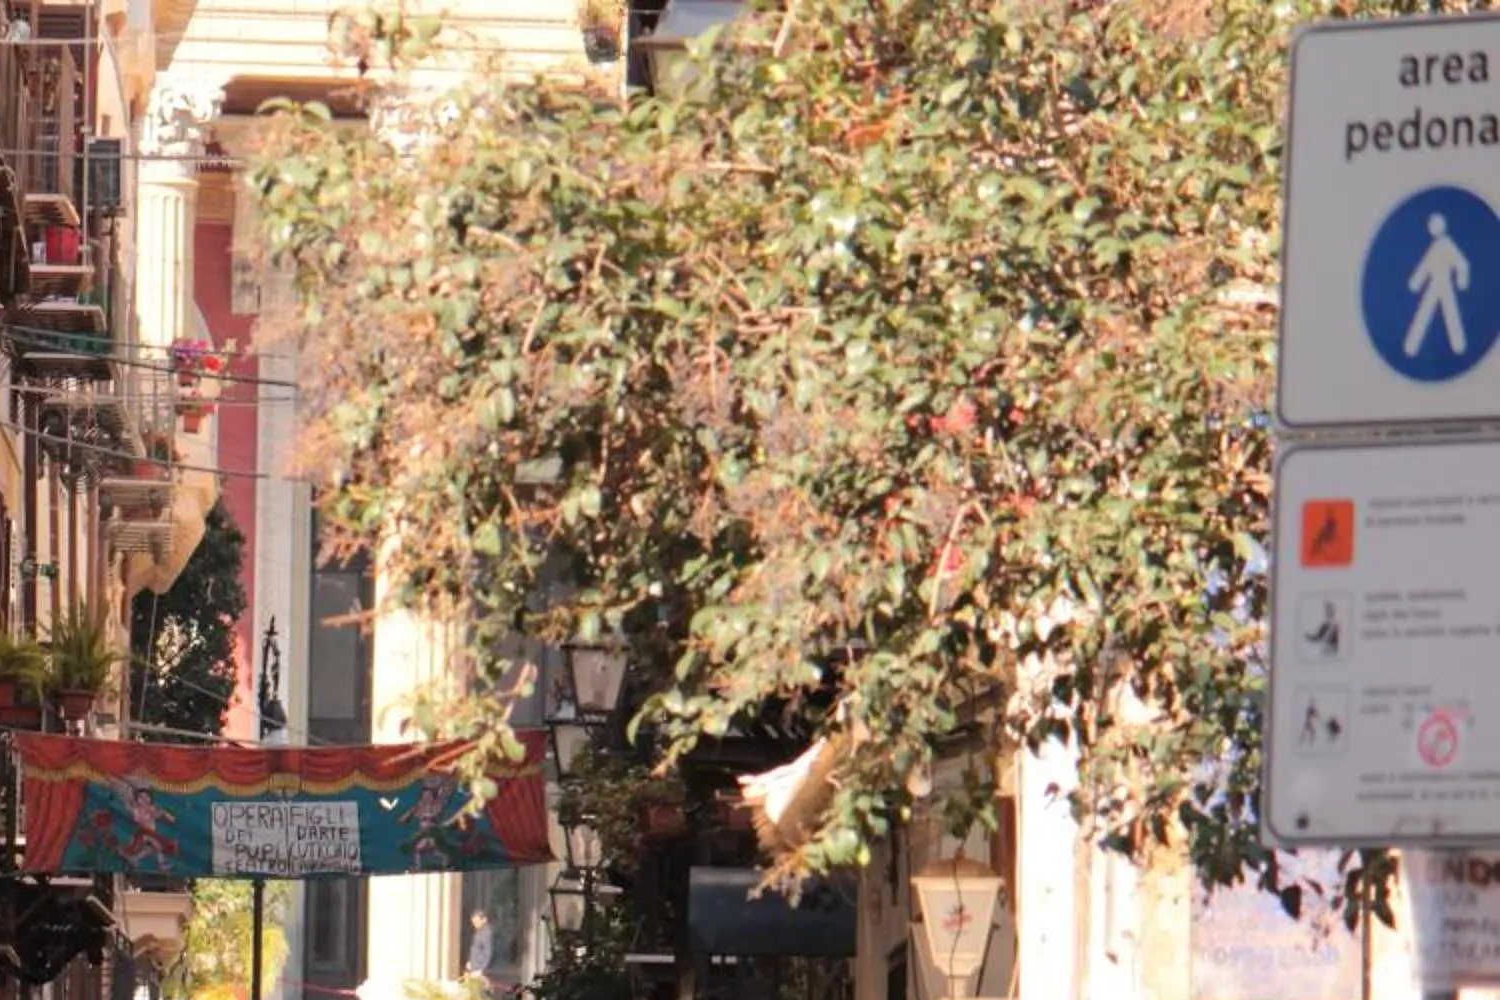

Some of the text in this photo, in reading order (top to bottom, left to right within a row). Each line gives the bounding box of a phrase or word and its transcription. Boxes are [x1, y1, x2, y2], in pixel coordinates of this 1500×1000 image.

[1399, 51, 1489, 87] area
[213, 803, 345, 829] OPERA FIGLI
